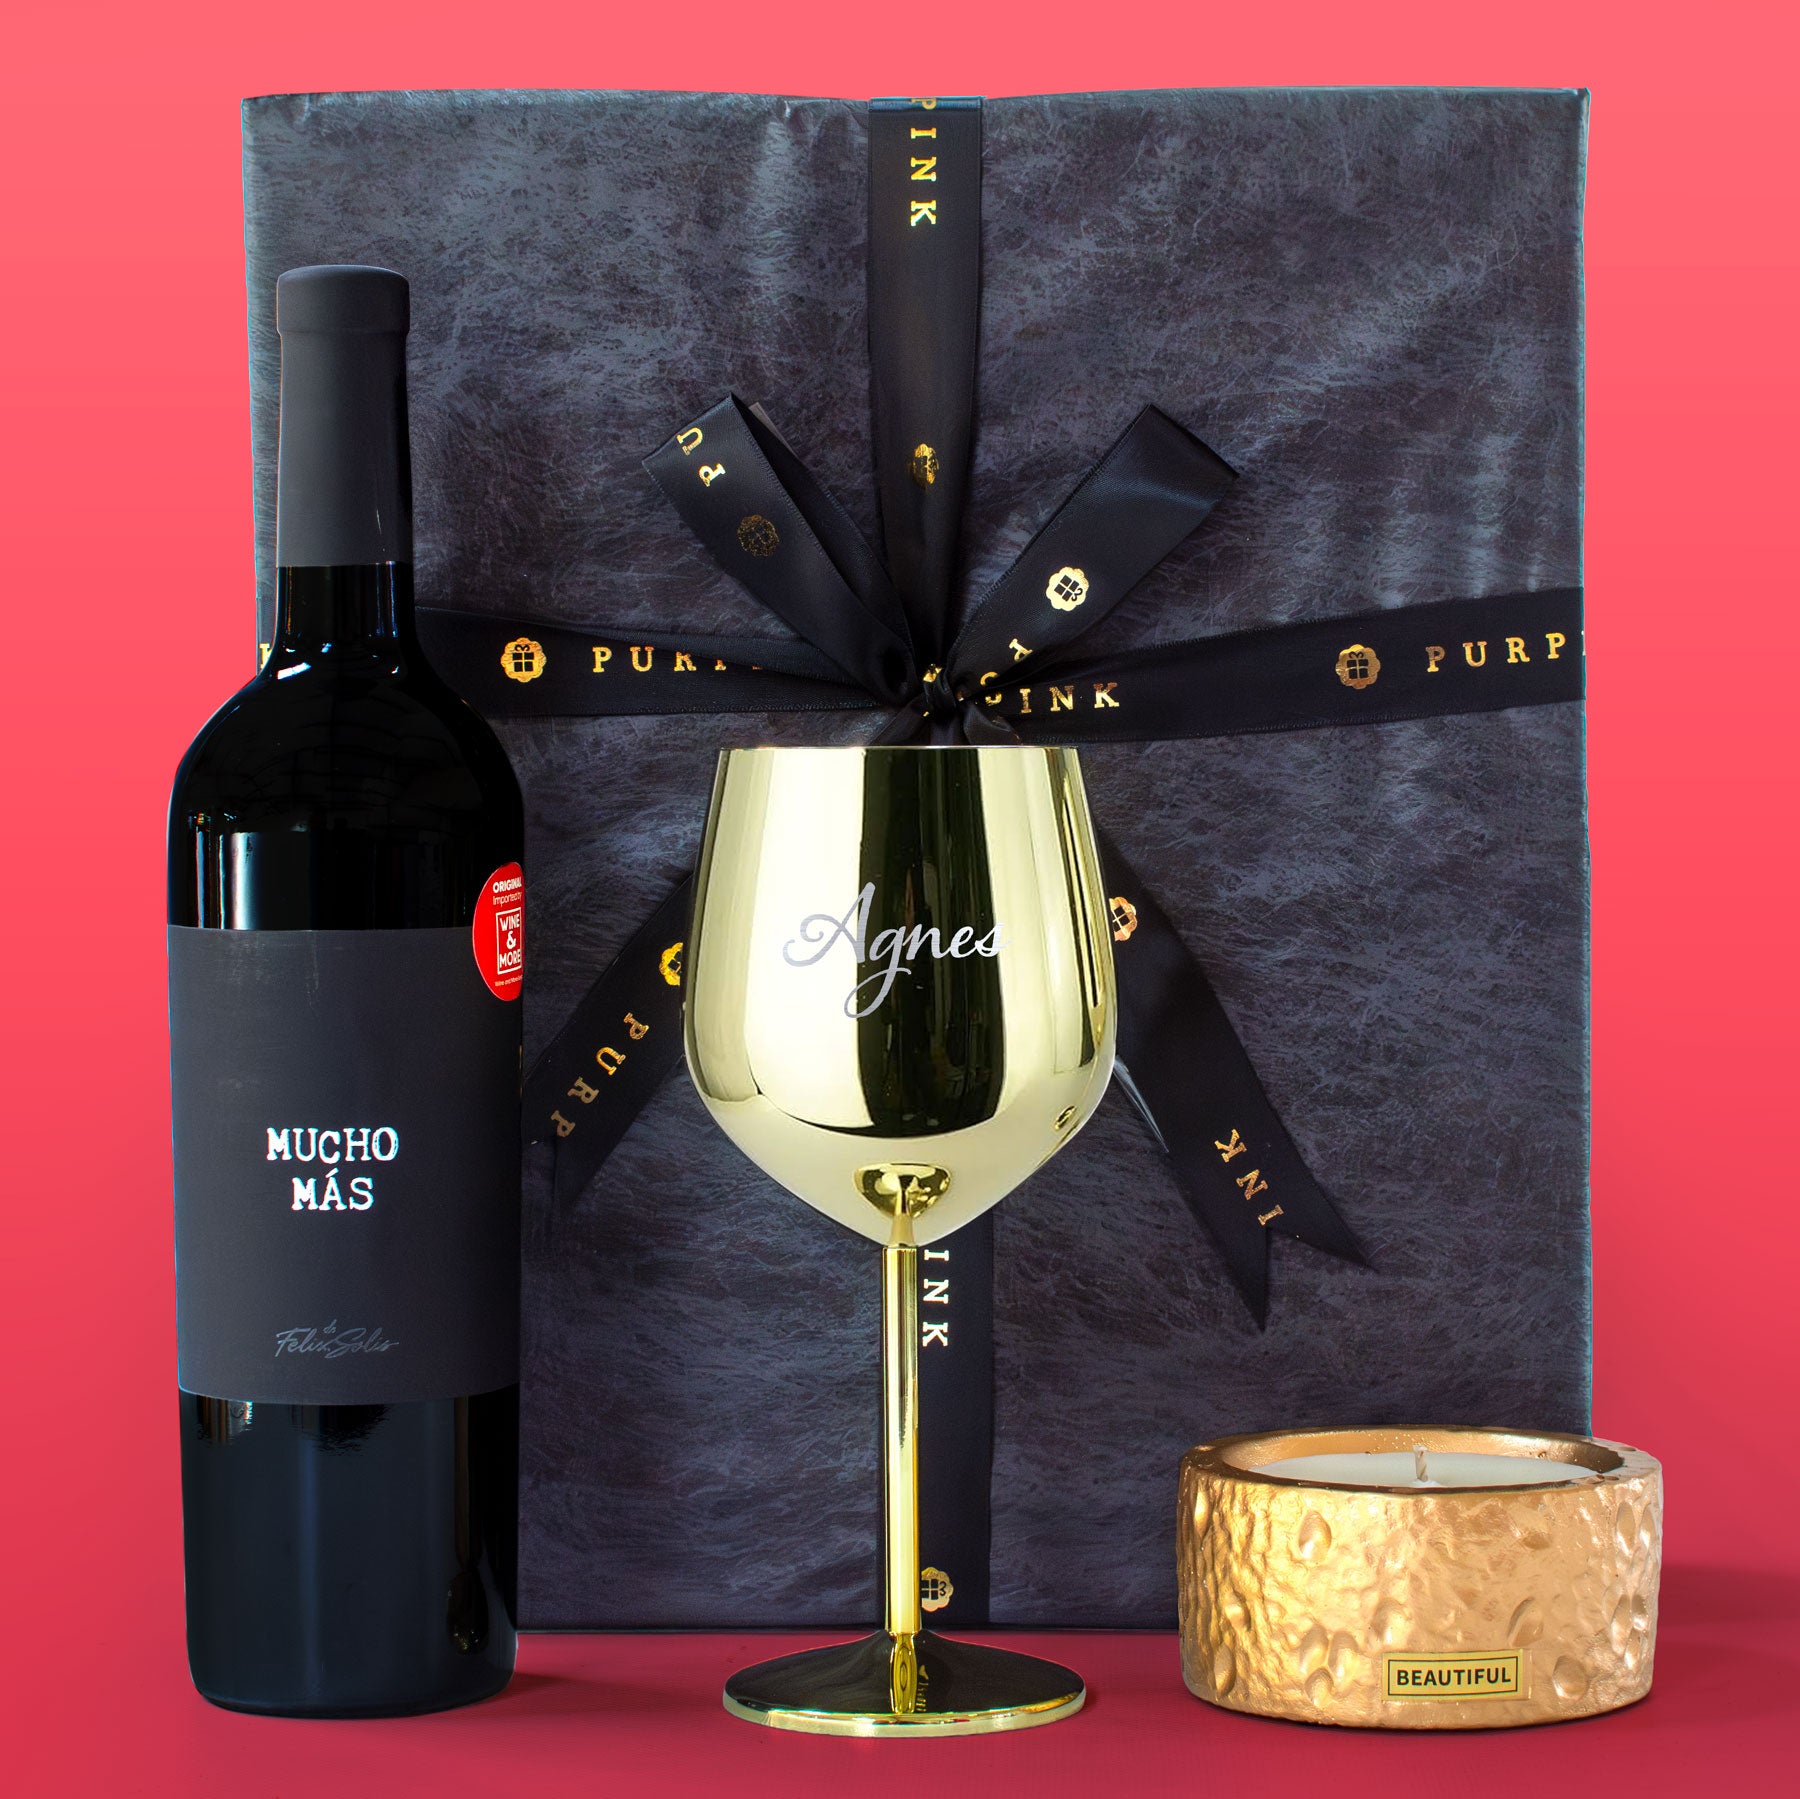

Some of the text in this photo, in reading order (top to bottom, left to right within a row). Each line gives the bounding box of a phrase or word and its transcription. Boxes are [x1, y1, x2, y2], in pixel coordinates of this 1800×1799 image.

[1425, 632, 1586, 673] PURP
[499, 913, 520, 931] WINE
[506, 931, 517, 949] &
[499, 949, 521, 968] MORE
[782, 881, 1012, 1018] Agnes
[266, 1126, 399, 1164] MUCHO
[291, 1167, 374, 1211] MÁS
[922, 1249, 950, 1347] INK
[1396, 1667, 1511, 1686] BEAUTIFUL
